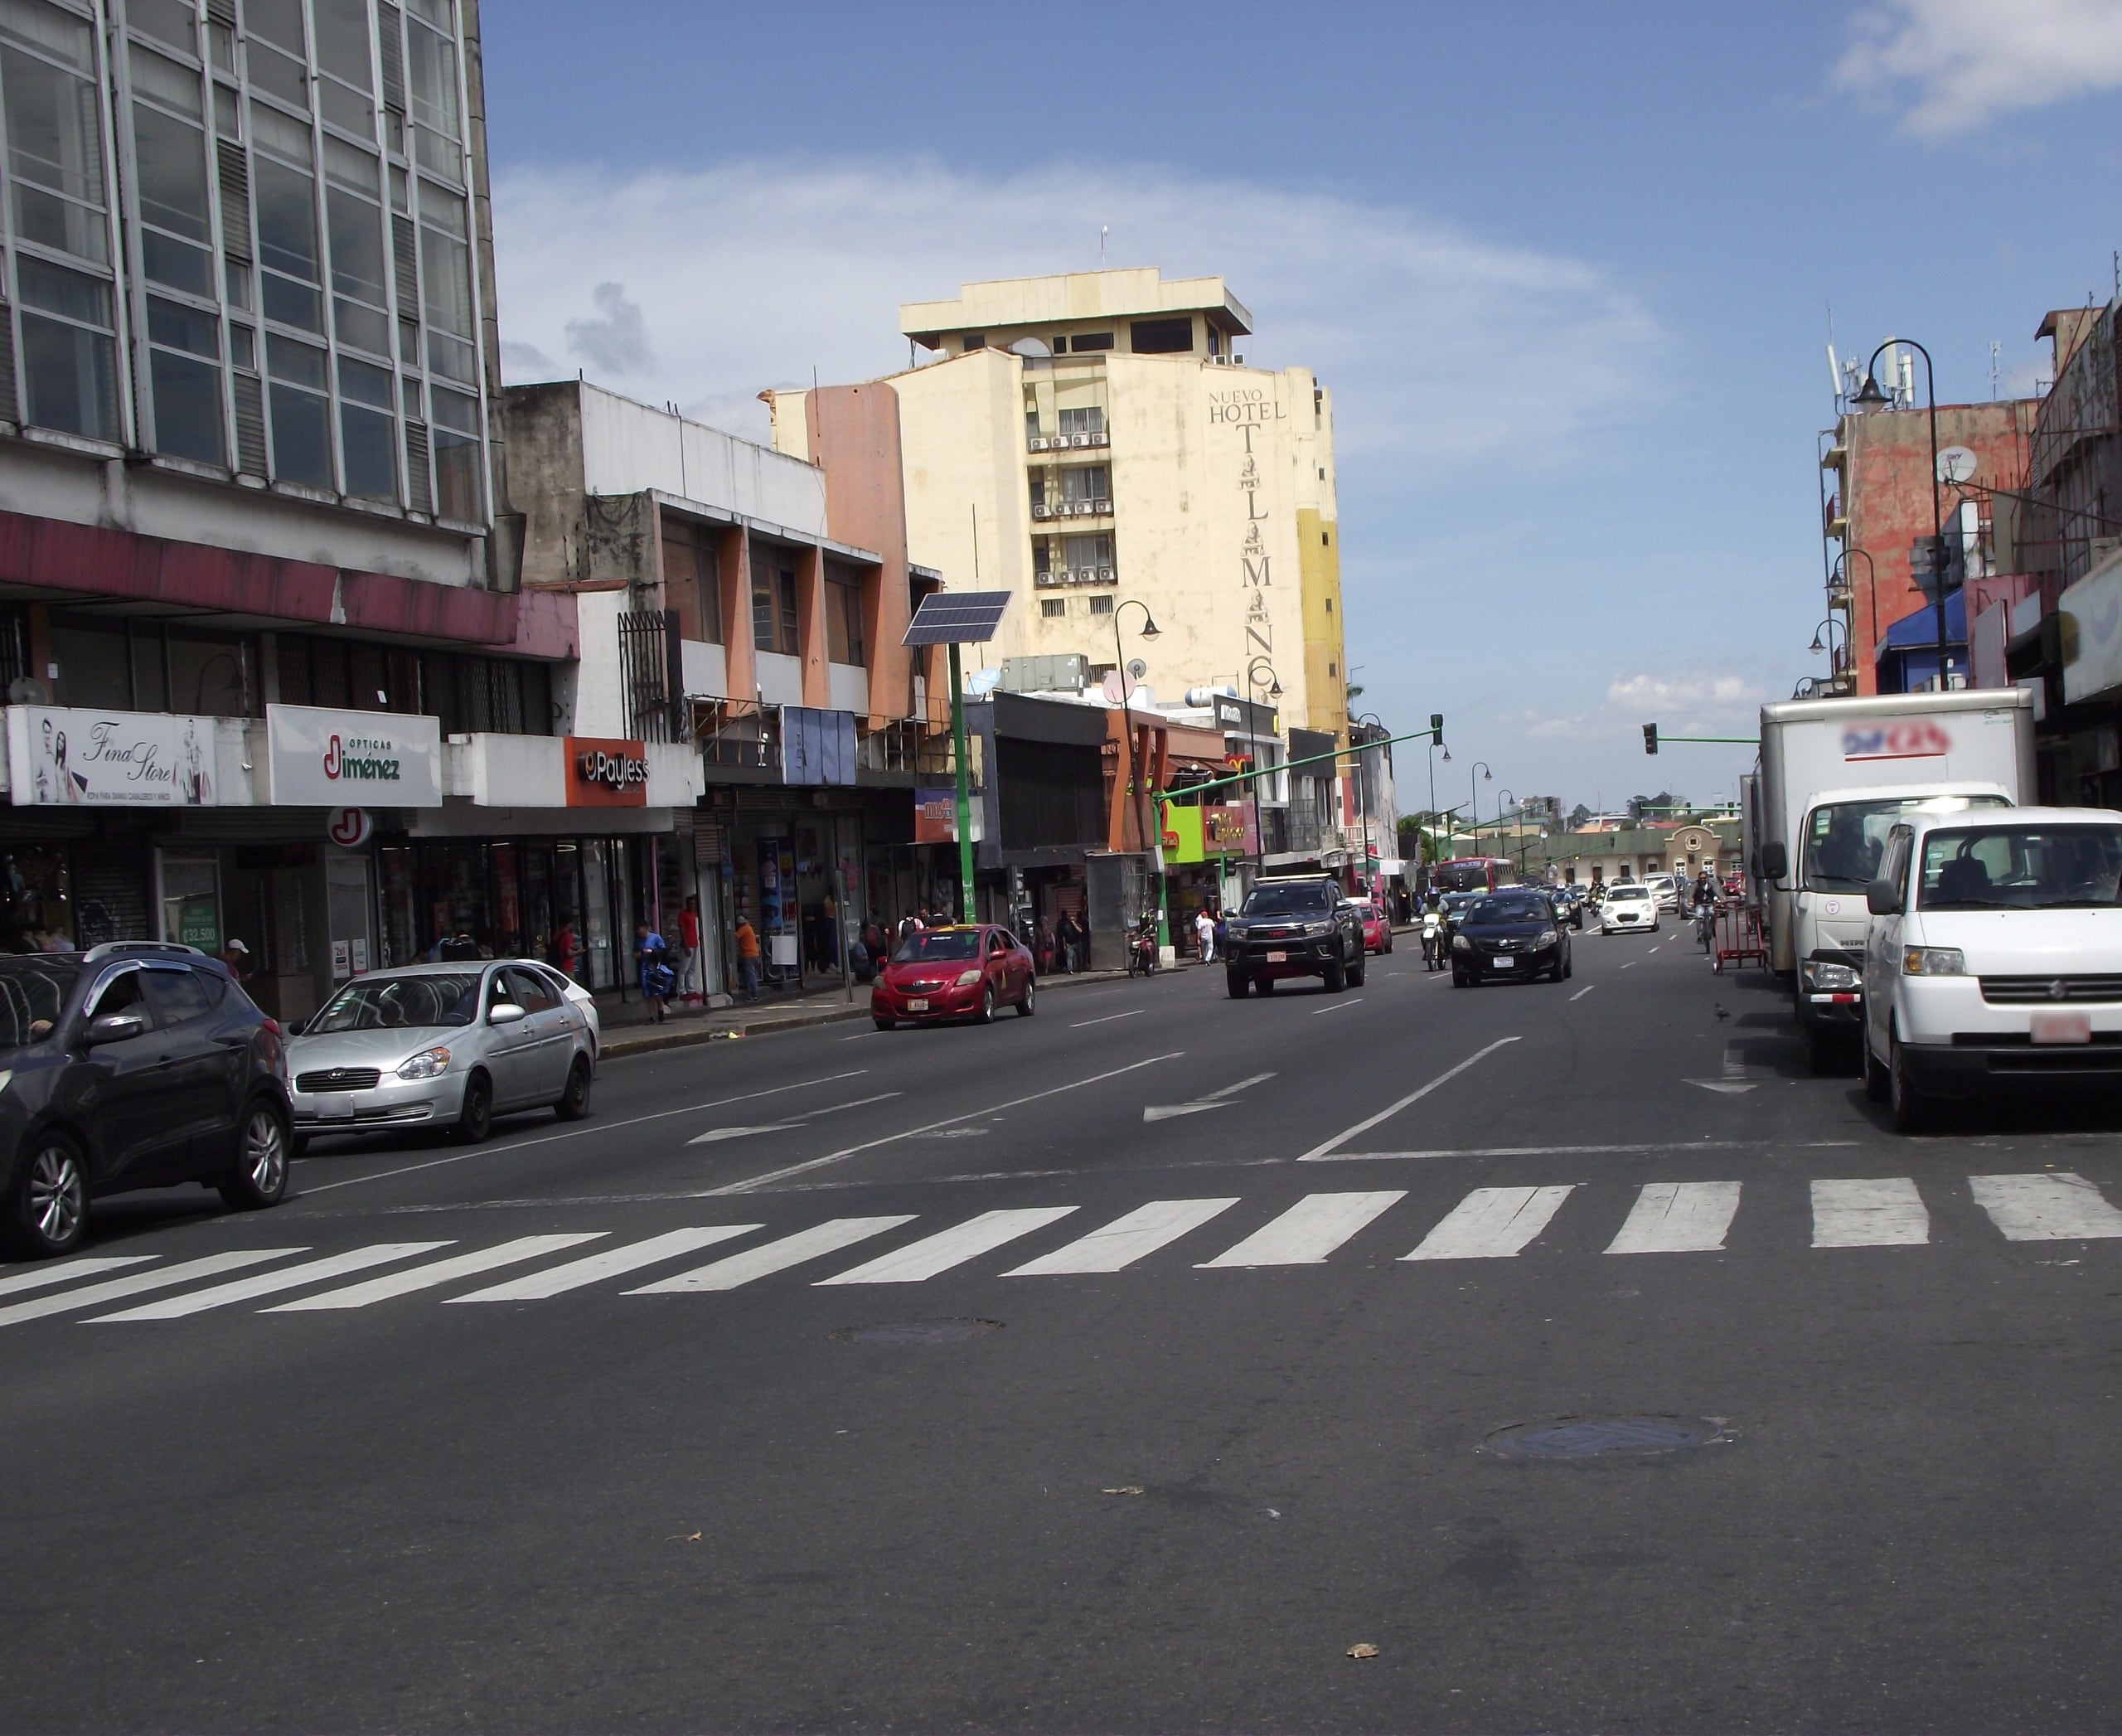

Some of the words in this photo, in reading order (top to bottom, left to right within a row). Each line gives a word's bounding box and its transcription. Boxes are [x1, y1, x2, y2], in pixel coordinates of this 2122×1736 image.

[1209, 389, 1262, 405] NUEVO
[1209, 401, 1287, 424] HOTEL
[83, 721, 133, 762] Fina
[127, 741, 171, 781] Store
[324, 735, 400, 780] Jiménez
[349, 738, 392, 750] OPTICAS
[597, 751, 651, 790] Payless
